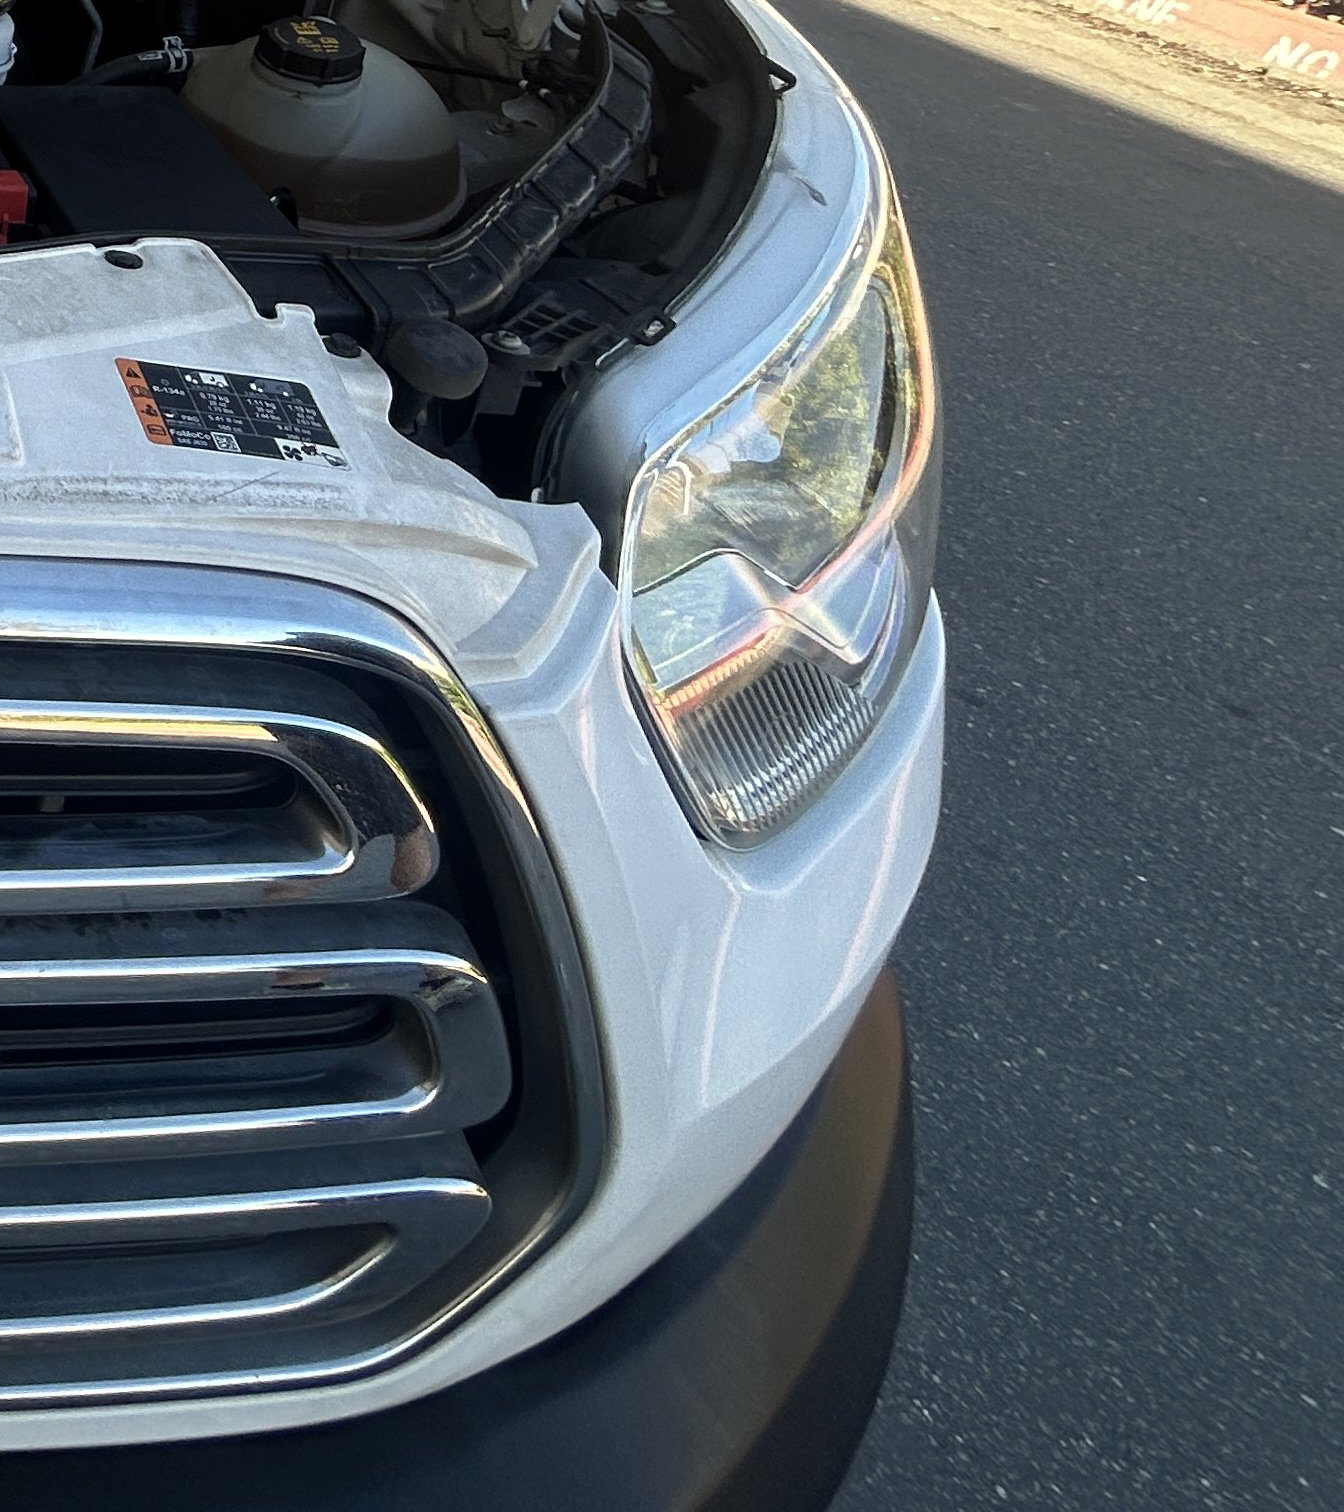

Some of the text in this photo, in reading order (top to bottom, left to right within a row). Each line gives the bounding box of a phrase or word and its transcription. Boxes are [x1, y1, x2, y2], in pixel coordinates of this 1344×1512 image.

[1261, 35, 1340, 80] NO
[152, 385, 185, 396] R-134a
[169, 428, 212, 441] FoMoCo
